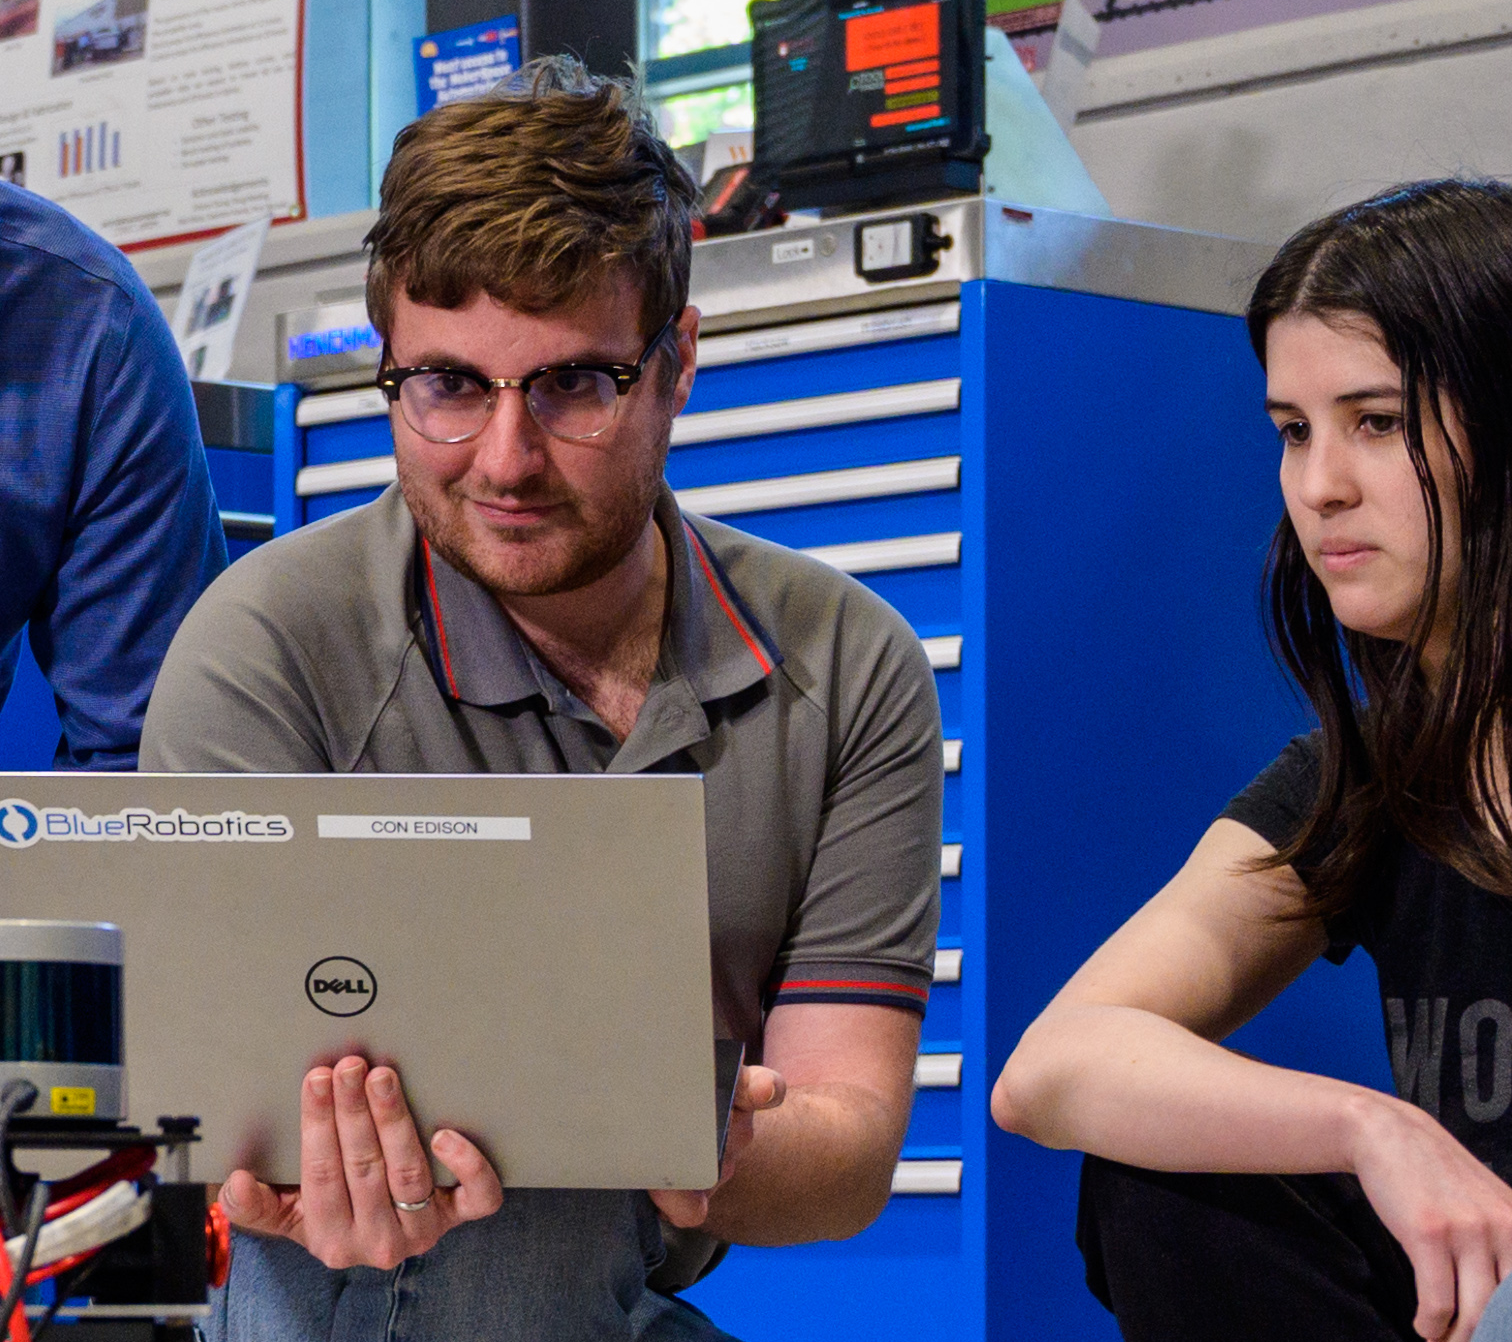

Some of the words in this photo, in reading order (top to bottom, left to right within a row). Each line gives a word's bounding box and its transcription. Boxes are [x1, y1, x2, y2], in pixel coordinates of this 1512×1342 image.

[45, 811, 289, 839] BlueRobotics
[371, 820, 410, 835] CON
[413, 820, 479, 835] EDISON
[313, 978, 369, 995] DELL
